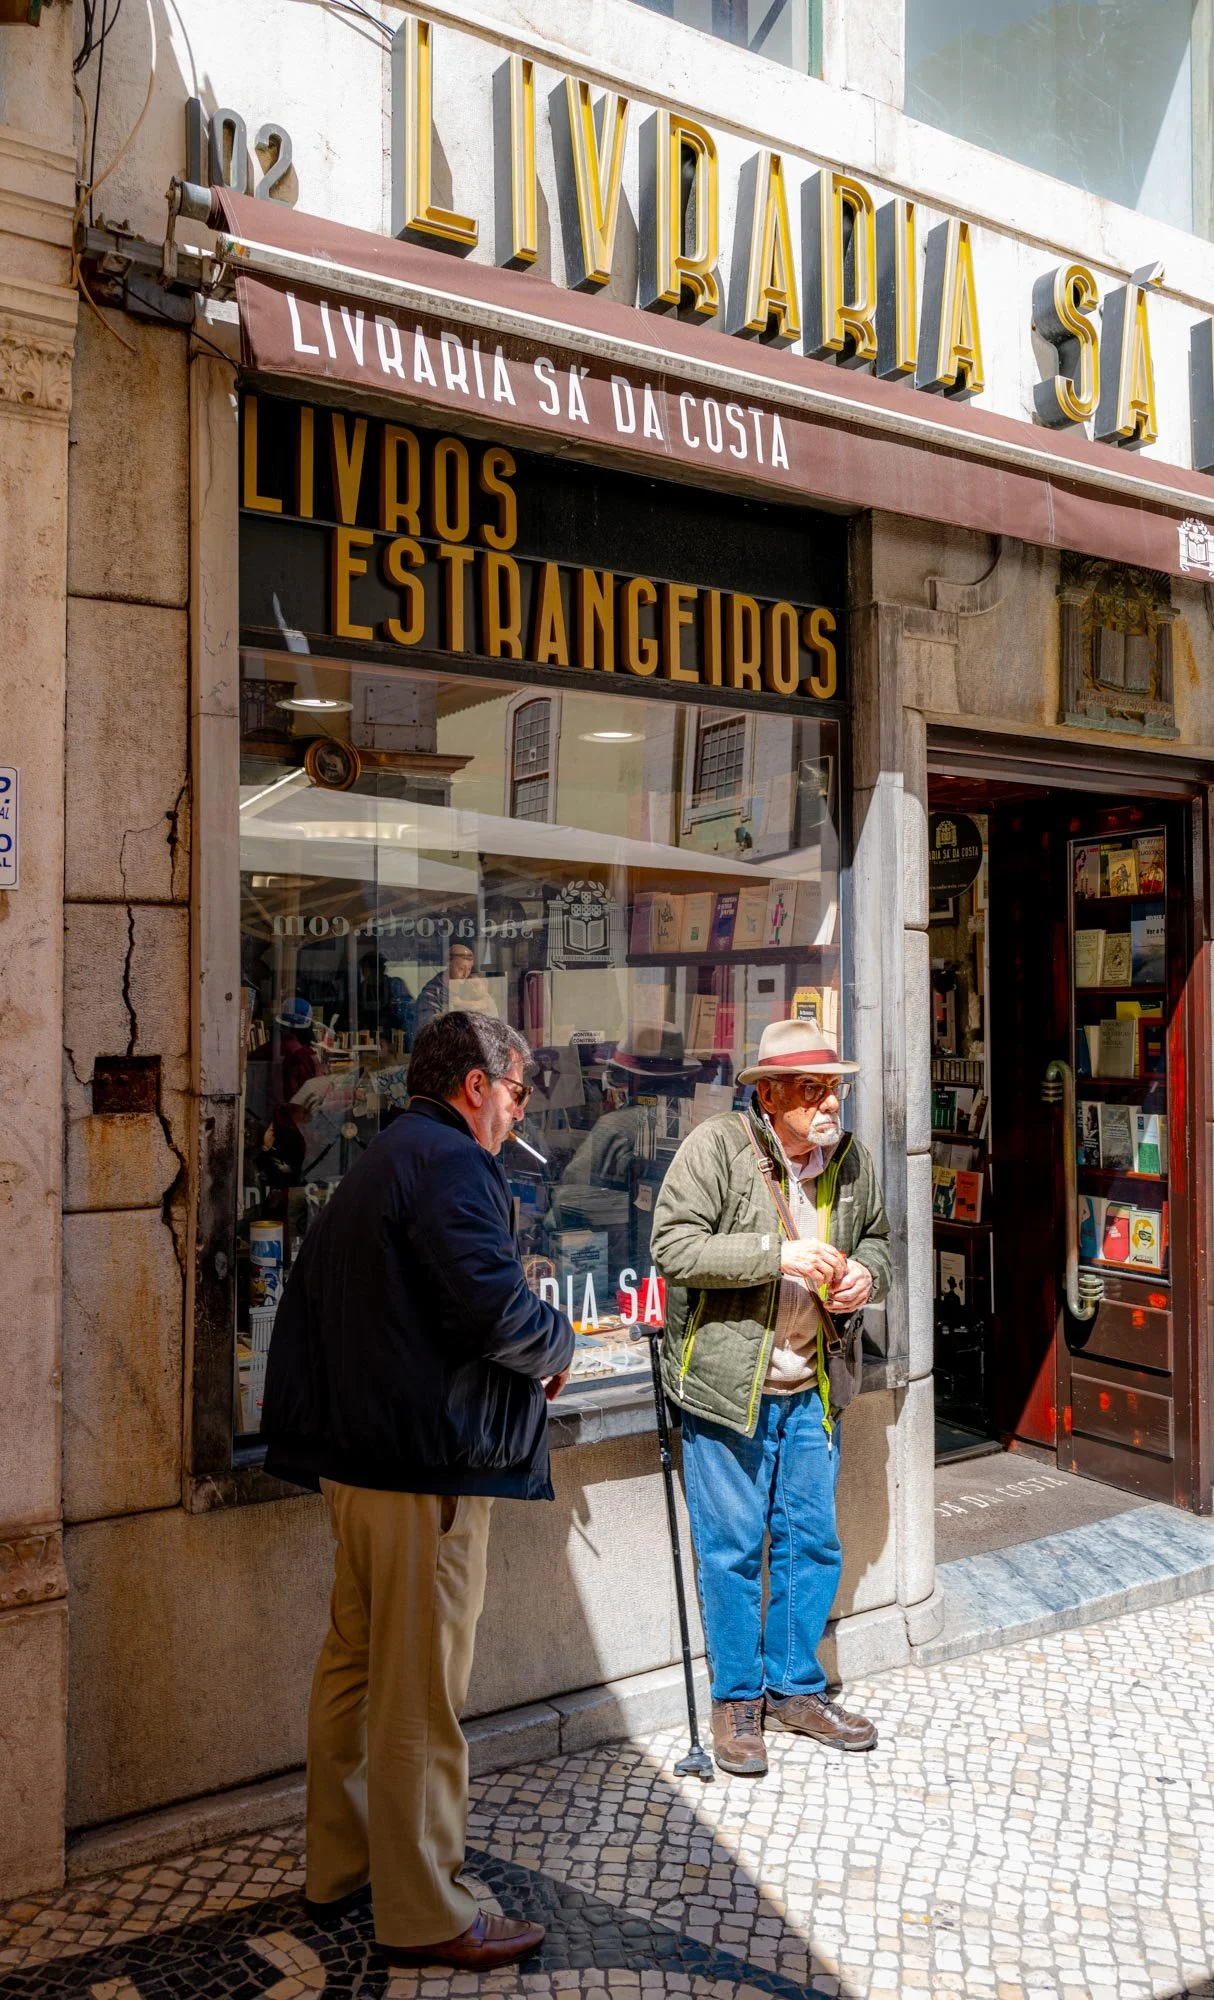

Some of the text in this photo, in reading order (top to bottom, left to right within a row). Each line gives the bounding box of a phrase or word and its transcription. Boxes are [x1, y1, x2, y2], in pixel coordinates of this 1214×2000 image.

[186, 97, 292, 198] 102
[392, 16, 985, 400] LIVRARIA
[1032, 260, 1166, 450] SÁ
[286, 292, 790, 470] LIVRARIA SÁ DA COSTA
[243, 396, 518, 551] LIVROS
[330, 526, 837, 700] ESTRANGEIROS
[960, 1493, 1004, 1508] DA
[995, 1475, 1068, 1498] COSTA
